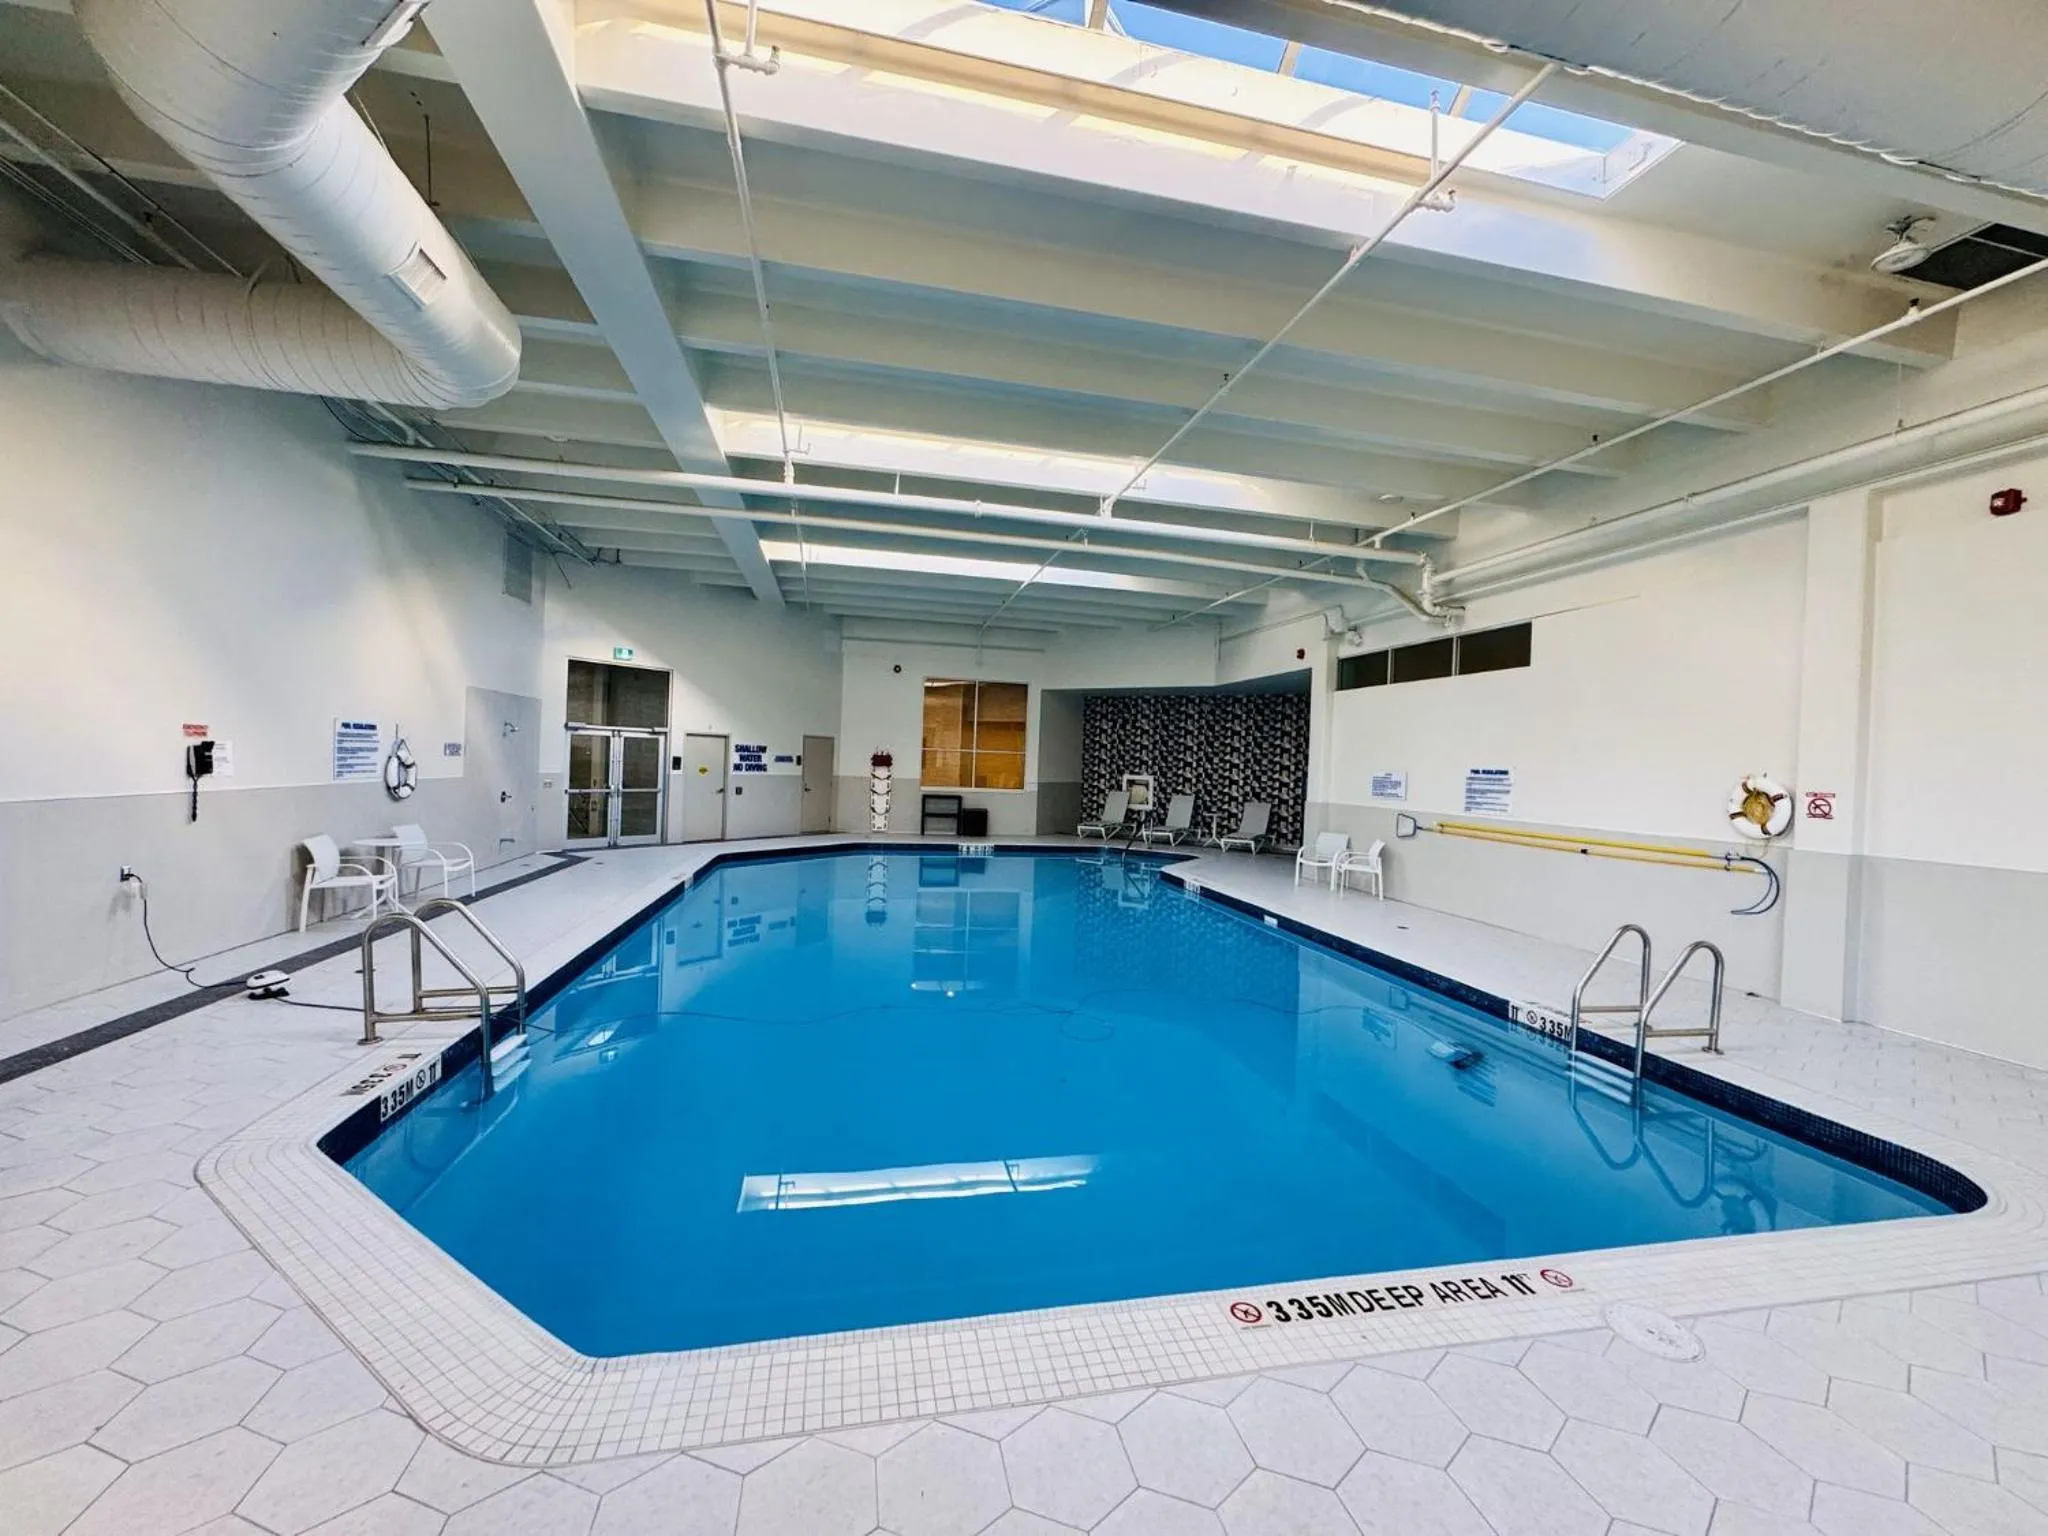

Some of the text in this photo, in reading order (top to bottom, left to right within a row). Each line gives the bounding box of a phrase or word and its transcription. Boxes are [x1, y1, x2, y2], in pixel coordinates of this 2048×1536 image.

[735, 744, 767, 754] SHALLOW
[739, 754, 762, 762] WATER
[733, 763, 767, 772] NO DIVING
[1429, 1277, 1508, 1304] AREA
